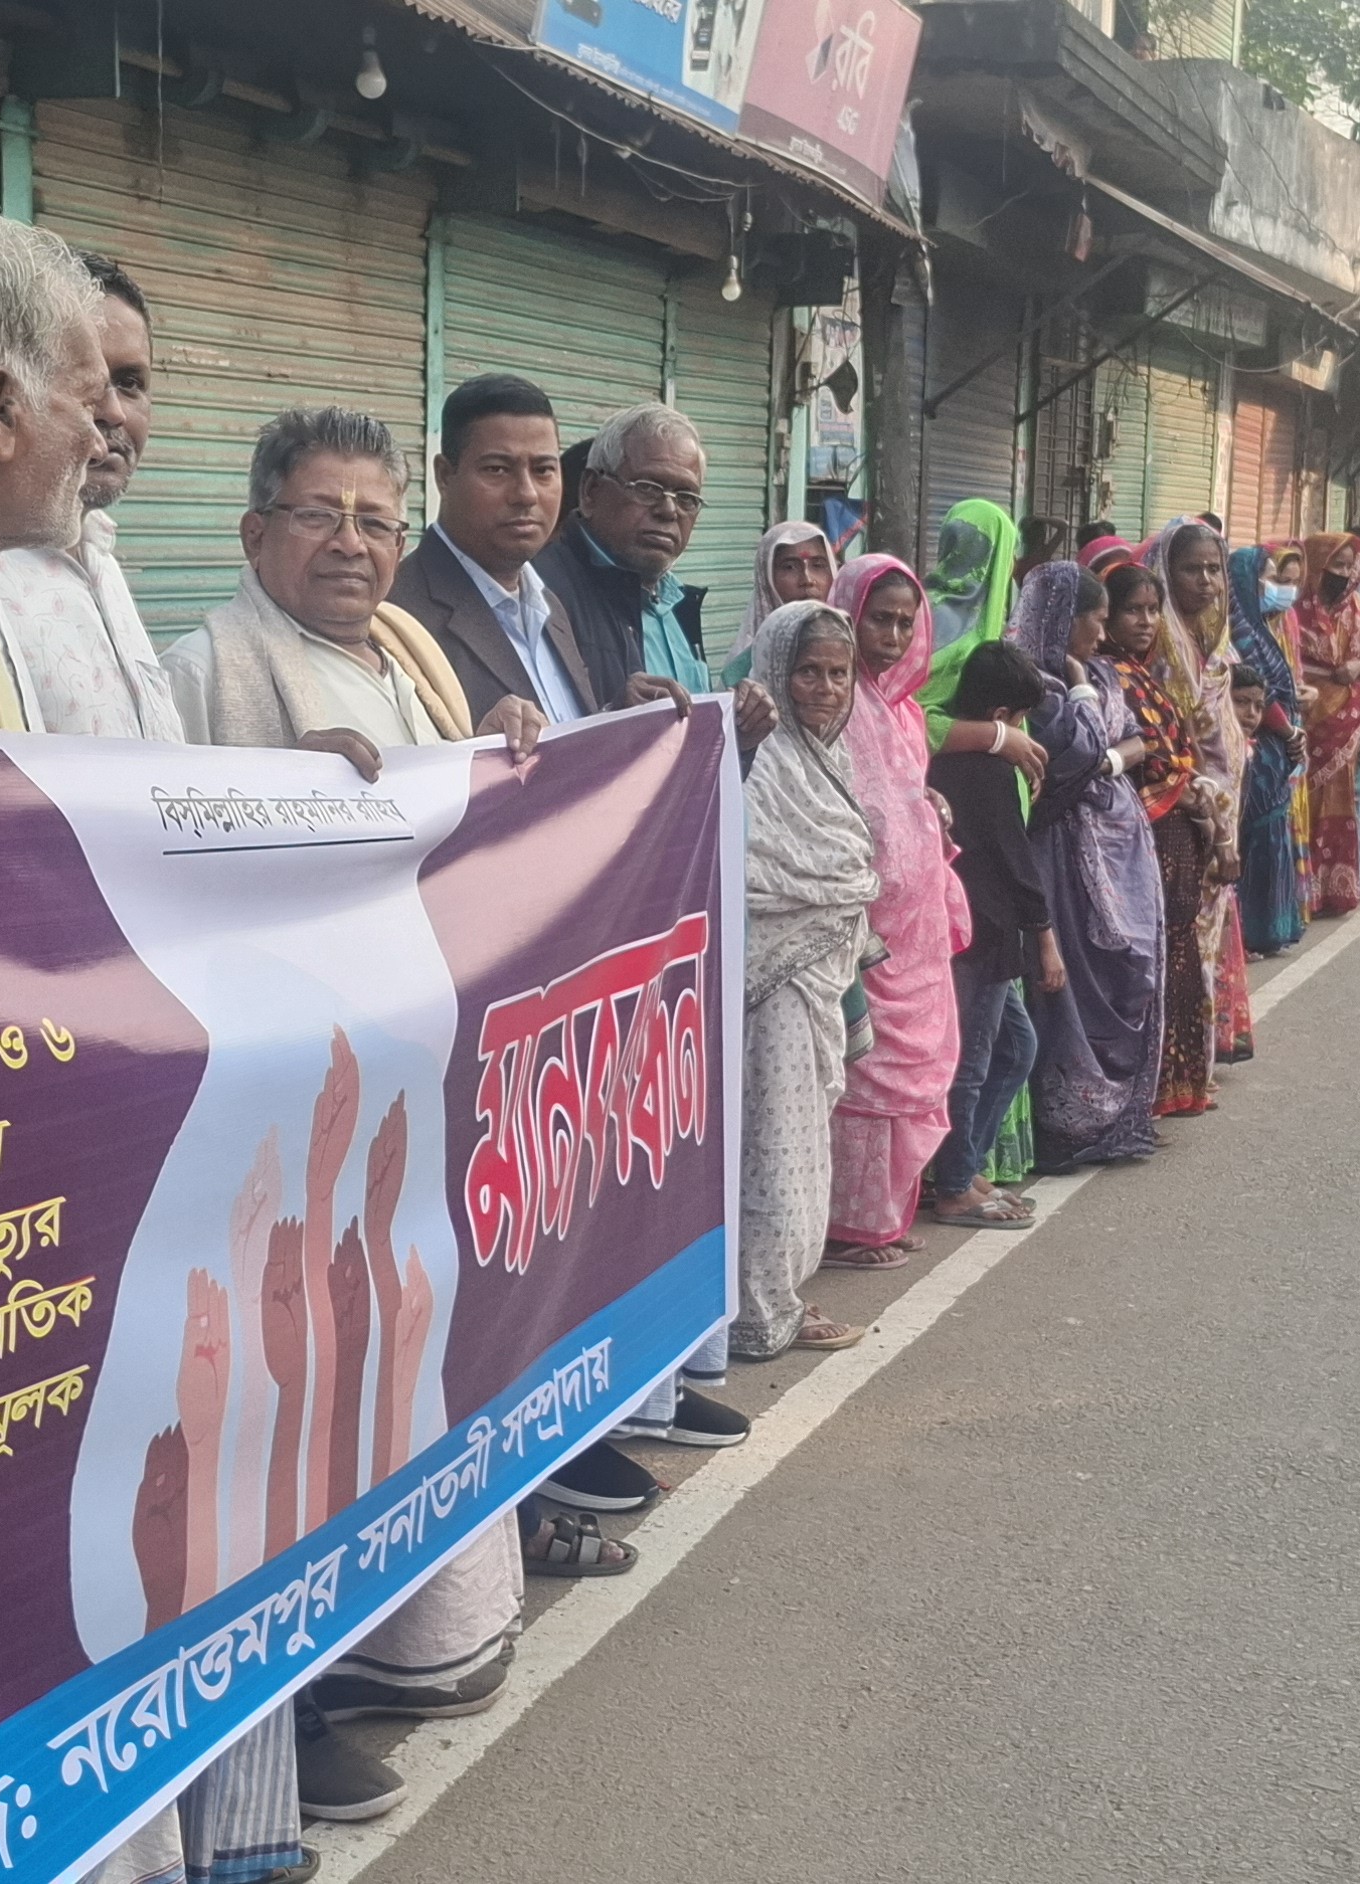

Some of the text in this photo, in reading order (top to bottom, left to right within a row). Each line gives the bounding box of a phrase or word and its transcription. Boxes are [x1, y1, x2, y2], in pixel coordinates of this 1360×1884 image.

[832, 10, 875, 100] রবি
[40, 1018, 76, 1062] ৬
[47, 1544, 349, 1794] নরোত্তমপুর
[357, 1415, 498, 1573] সনাতনী
[501, 1336, 613, 1458] সম্প্রদায়
